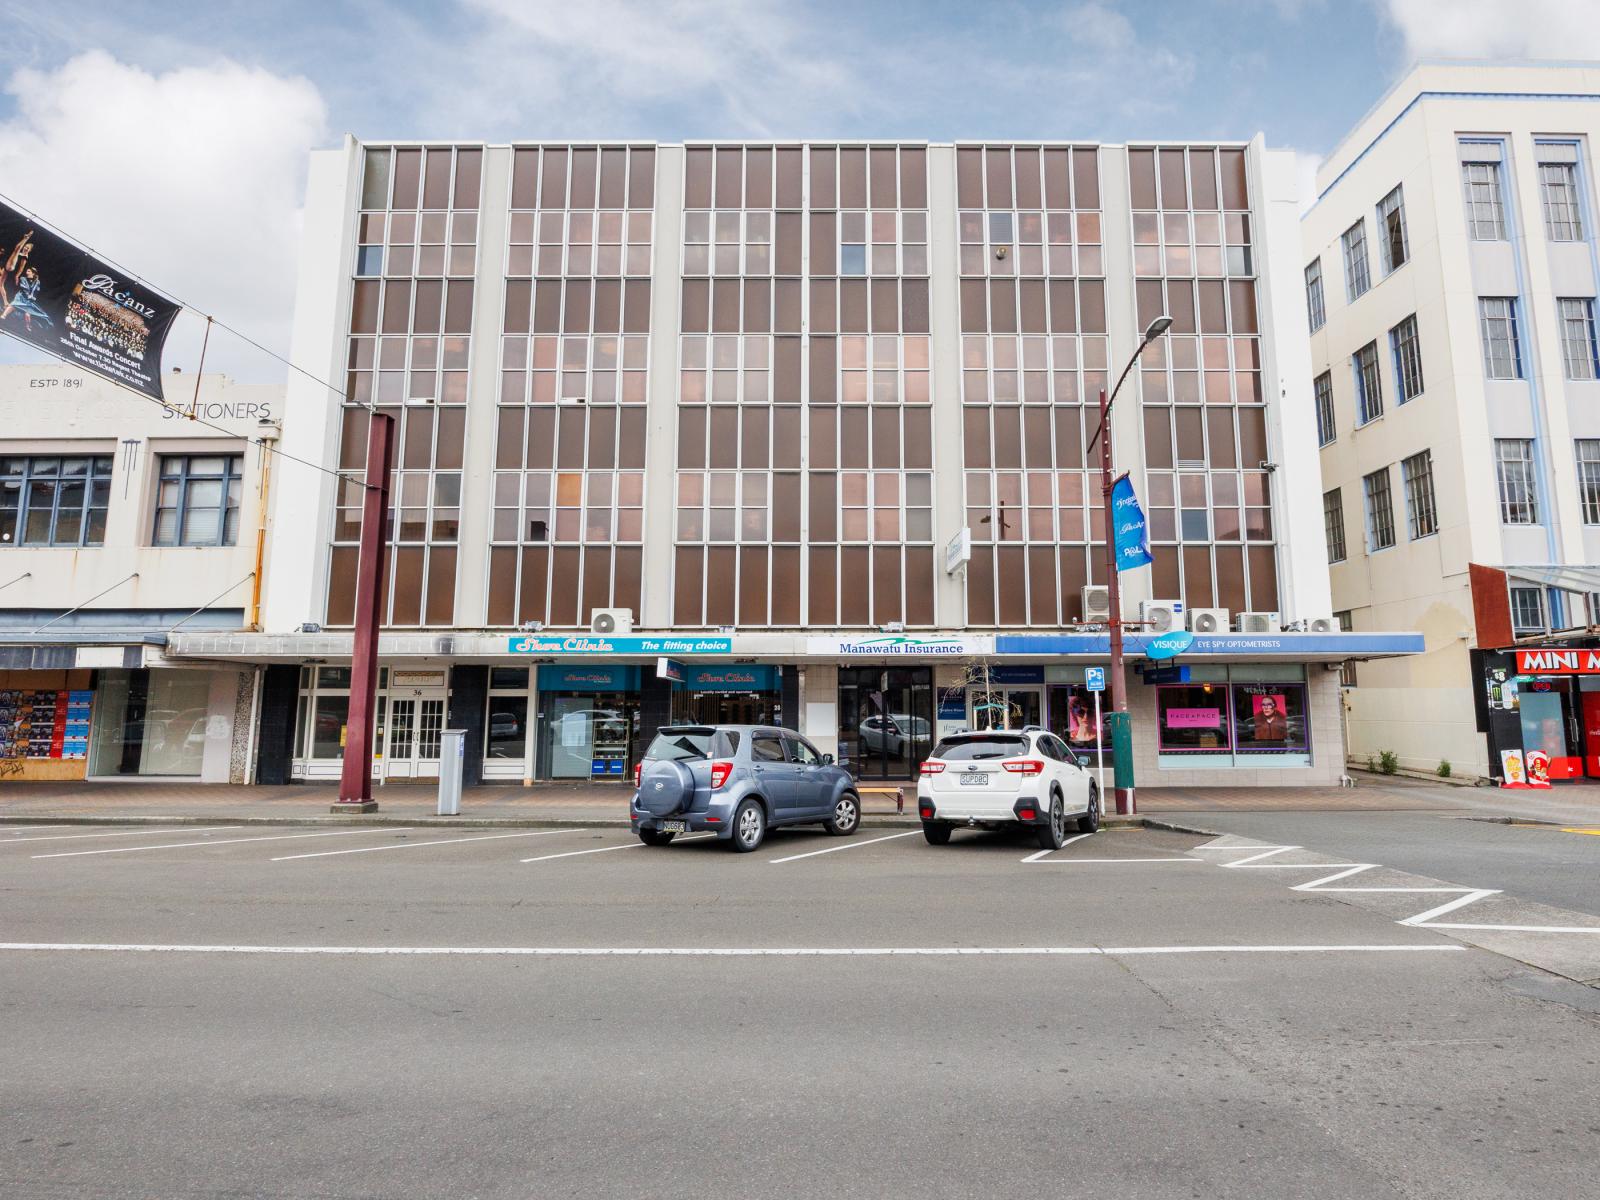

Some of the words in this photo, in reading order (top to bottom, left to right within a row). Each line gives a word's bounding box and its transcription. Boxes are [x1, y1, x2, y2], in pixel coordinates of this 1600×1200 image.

[70, 332, 87, 346] Final
[89, 341, 113, 358] Awards
[114, 352, 141, 370] Concert
[75, 344, 98, 359] October
[131, 368, 152, 382] Theatre
[63, 379, 83, 388] 1891
[162, 402, 271, 419] STATIONERS
[516, 638, 562, 652] Shoe
[563, 638, 614, 652] Clinic
[640, 641, 660, 651] The
[663, 641, 693, 653] fitting
[695, 641, 728, 651] choice
[840, 643, 901, 654] Manawatu
[904, 643, 963, 654] Insurance
[1152, 640, 1188, 651] VISIQUE
[1197, 640, 1212, 648] EYE
[1212, 640, 1225, 648] SPY
[1227, 640, 1281, 648] OPTOMETRISTS
[1523, 651, 1579, 669] MINI
